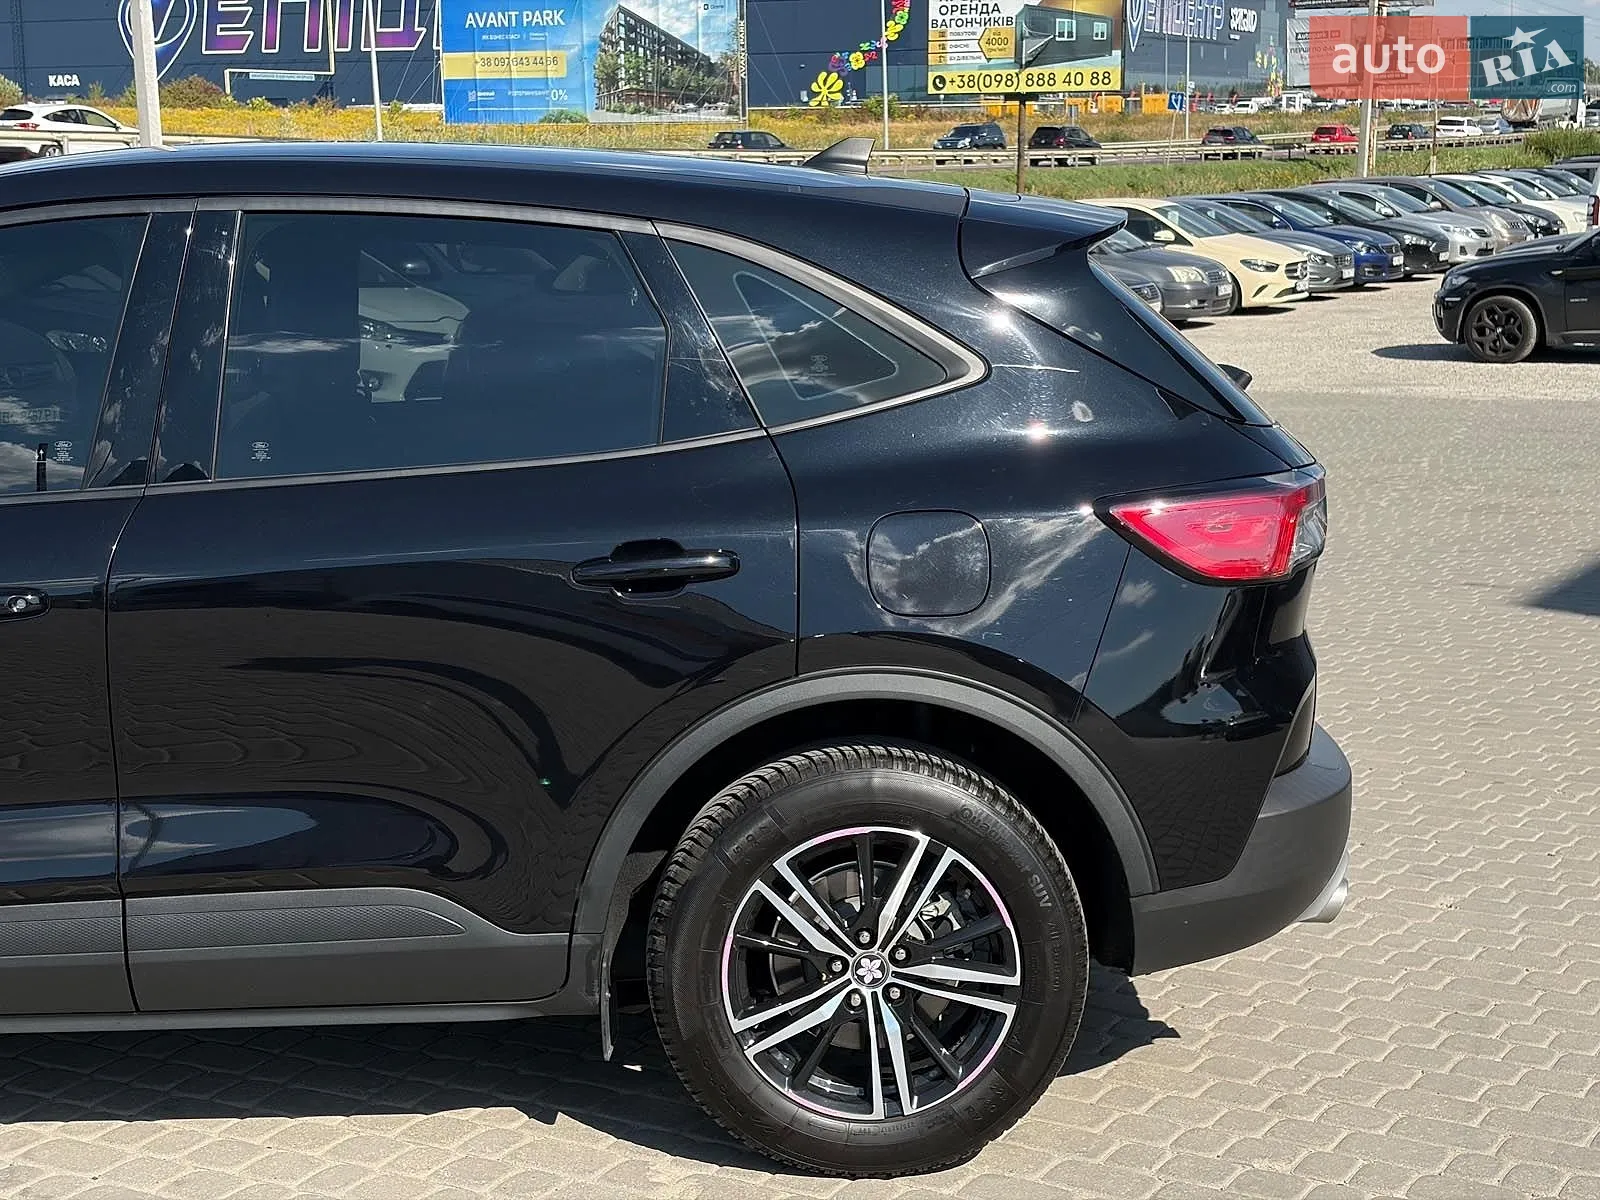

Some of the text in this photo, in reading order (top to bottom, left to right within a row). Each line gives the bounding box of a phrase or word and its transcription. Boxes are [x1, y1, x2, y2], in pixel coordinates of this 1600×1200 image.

[938, 3, 1001, 17] ОРЕНДА
[465, 9, 566, 29] AVANT PARK
[931, 16, 1014, 29] ВАГОНЧИКІВ
[985, 37, 1009, 46] 4000
[532, 57, 544, 67] 44
[49, 74, 80, 87] КАСА
[949, 71, 1112, 91] +38(098) 888 40 88
[550, 89, 568, 101] 0%
[1028, 874, 1052, 908] SUV
